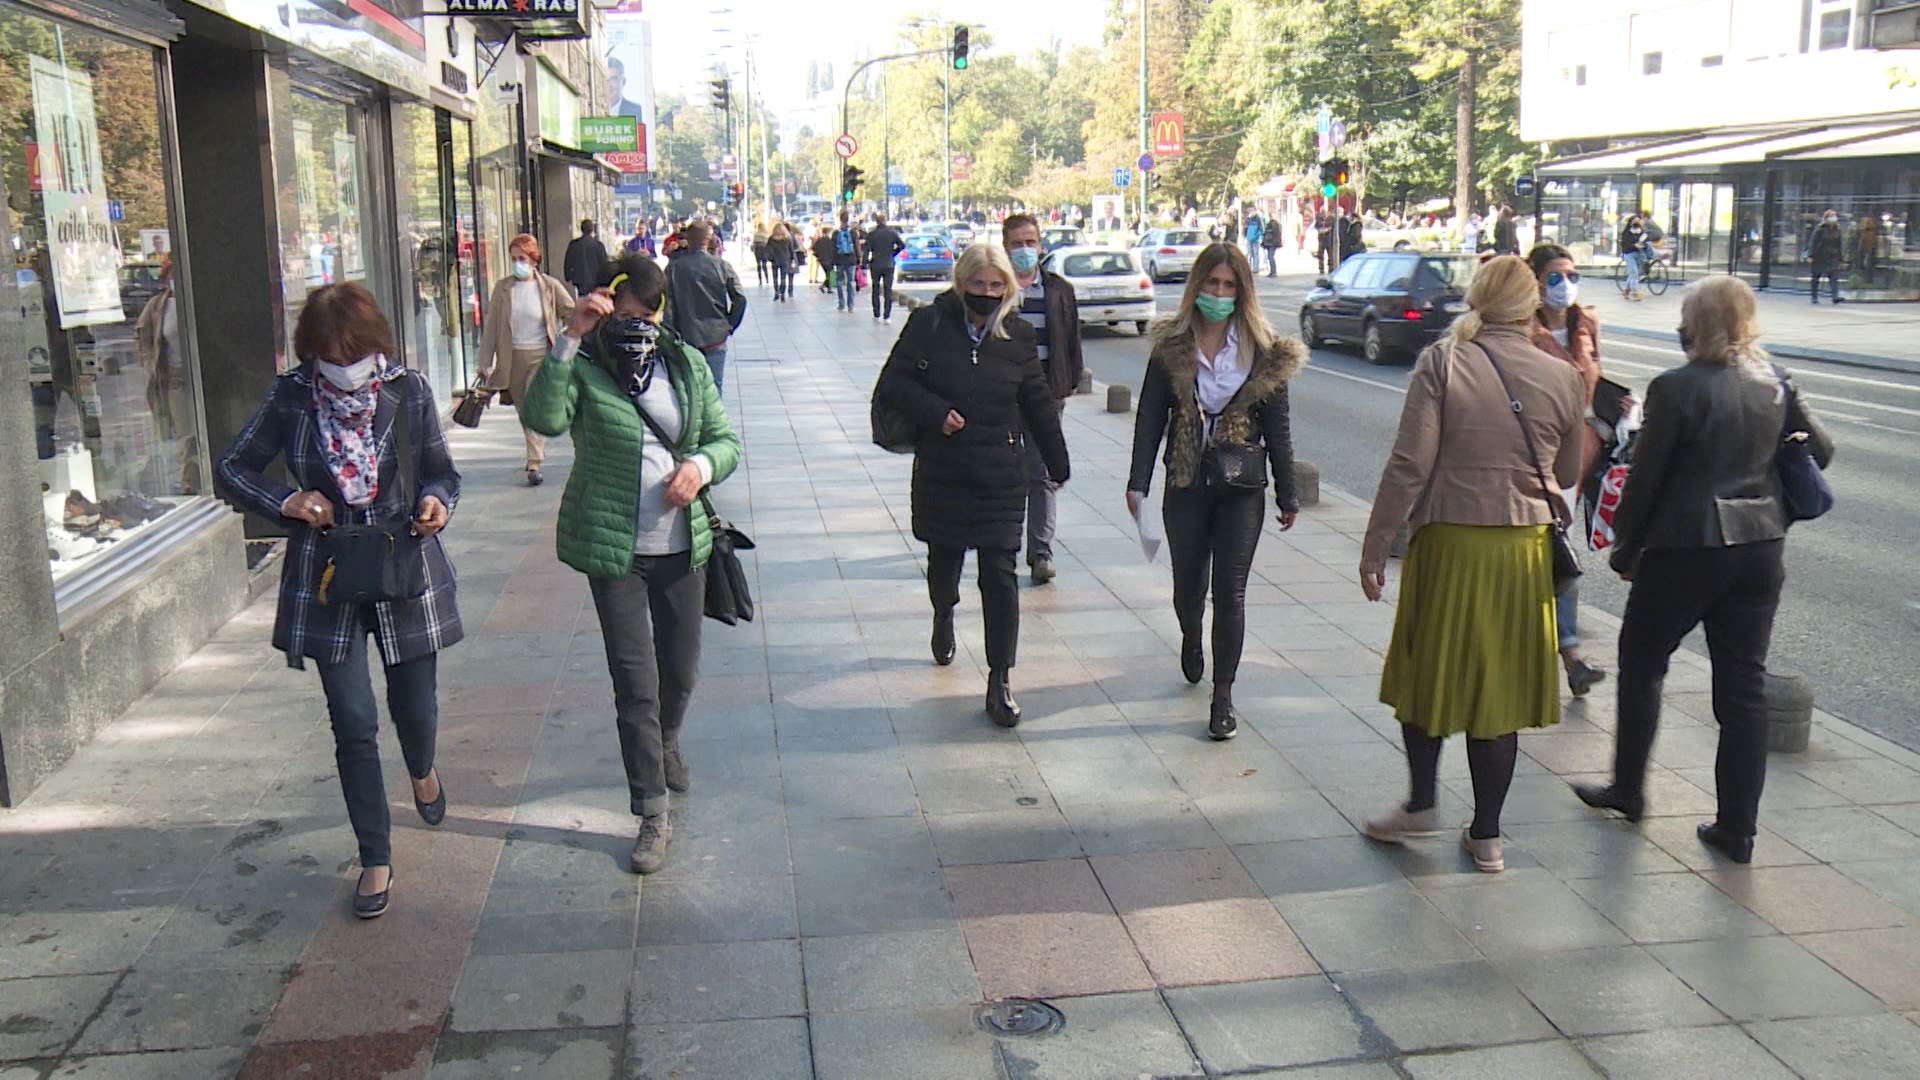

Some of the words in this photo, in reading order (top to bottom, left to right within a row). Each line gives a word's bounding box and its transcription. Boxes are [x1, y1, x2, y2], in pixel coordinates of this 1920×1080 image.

[449, 0, 509, 10] ALMA
[534, 0, 577, 11] RAS
[584, 125, 631, 136] BUREK
